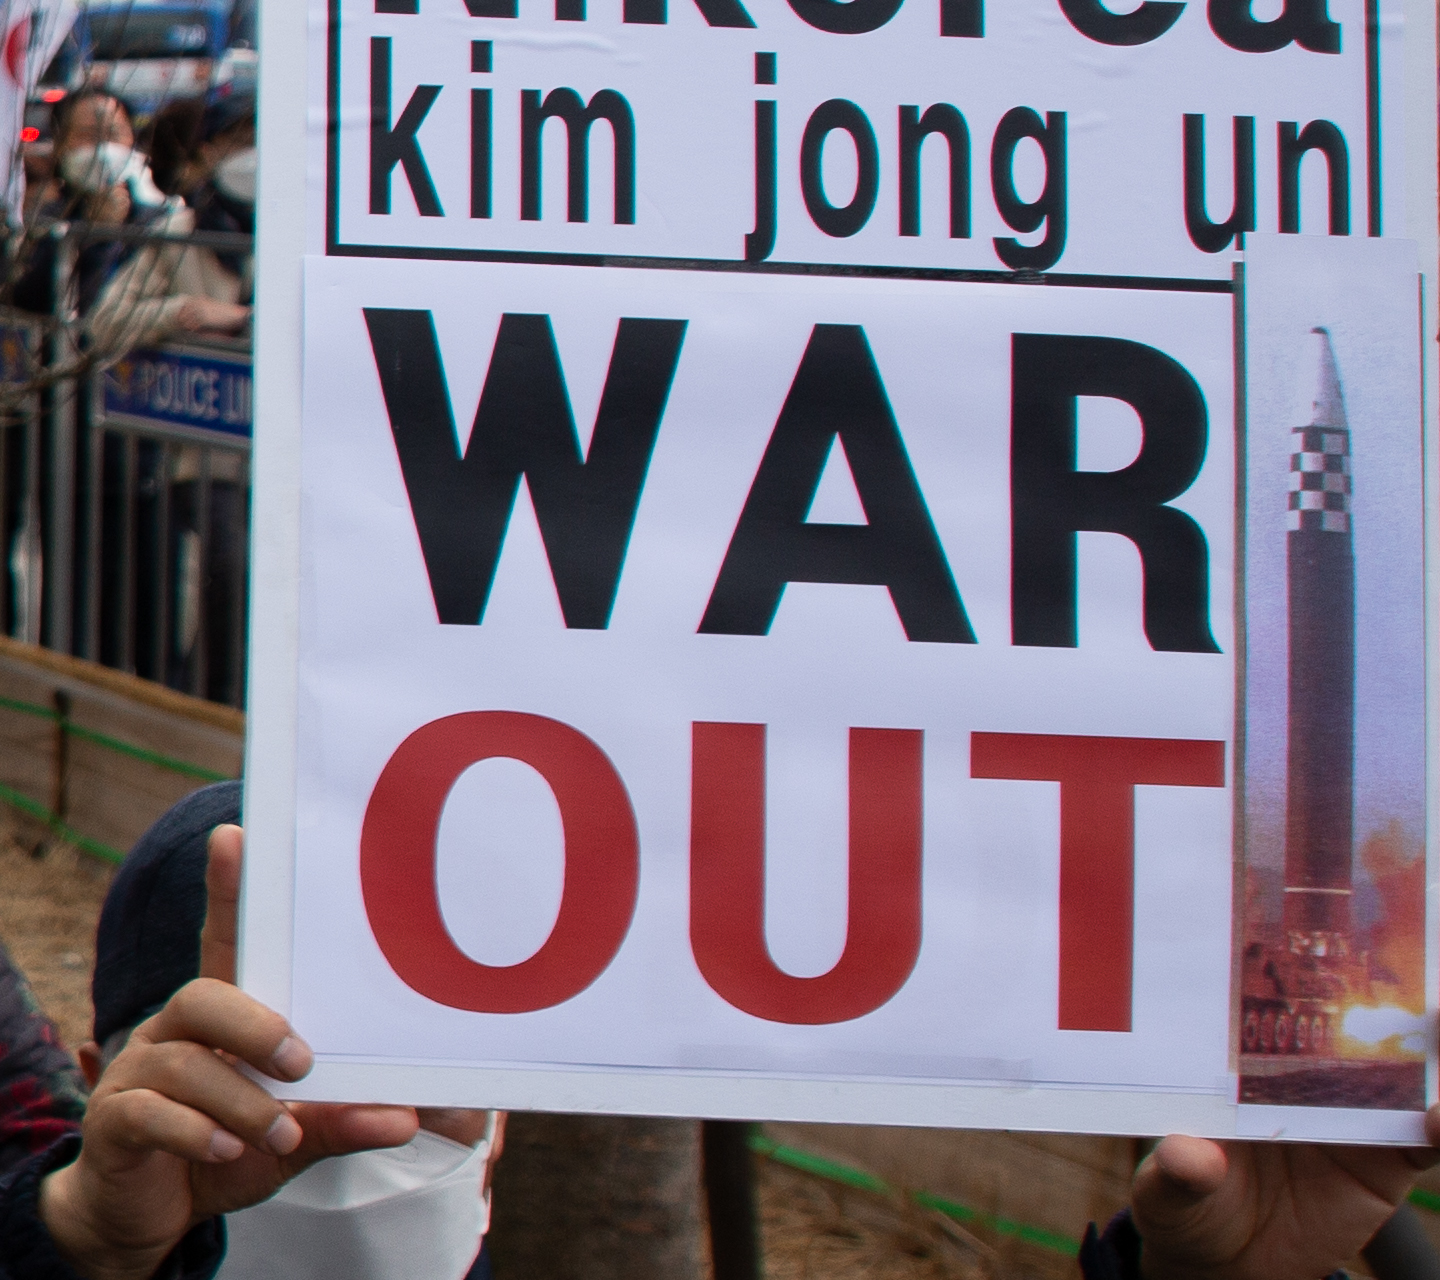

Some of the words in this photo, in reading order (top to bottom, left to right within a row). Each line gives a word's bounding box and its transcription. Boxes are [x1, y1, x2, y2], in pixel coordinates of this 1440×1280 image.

[369, 37, 637, 226] kim
[744, 52, 1067, 270] jong
[1183, 114, 1351, 254] un
[141, 359, 220, 420] POLICE
[362, 307, 1225, 654] WAR
[360, 710, 1227, 1034] OUT
